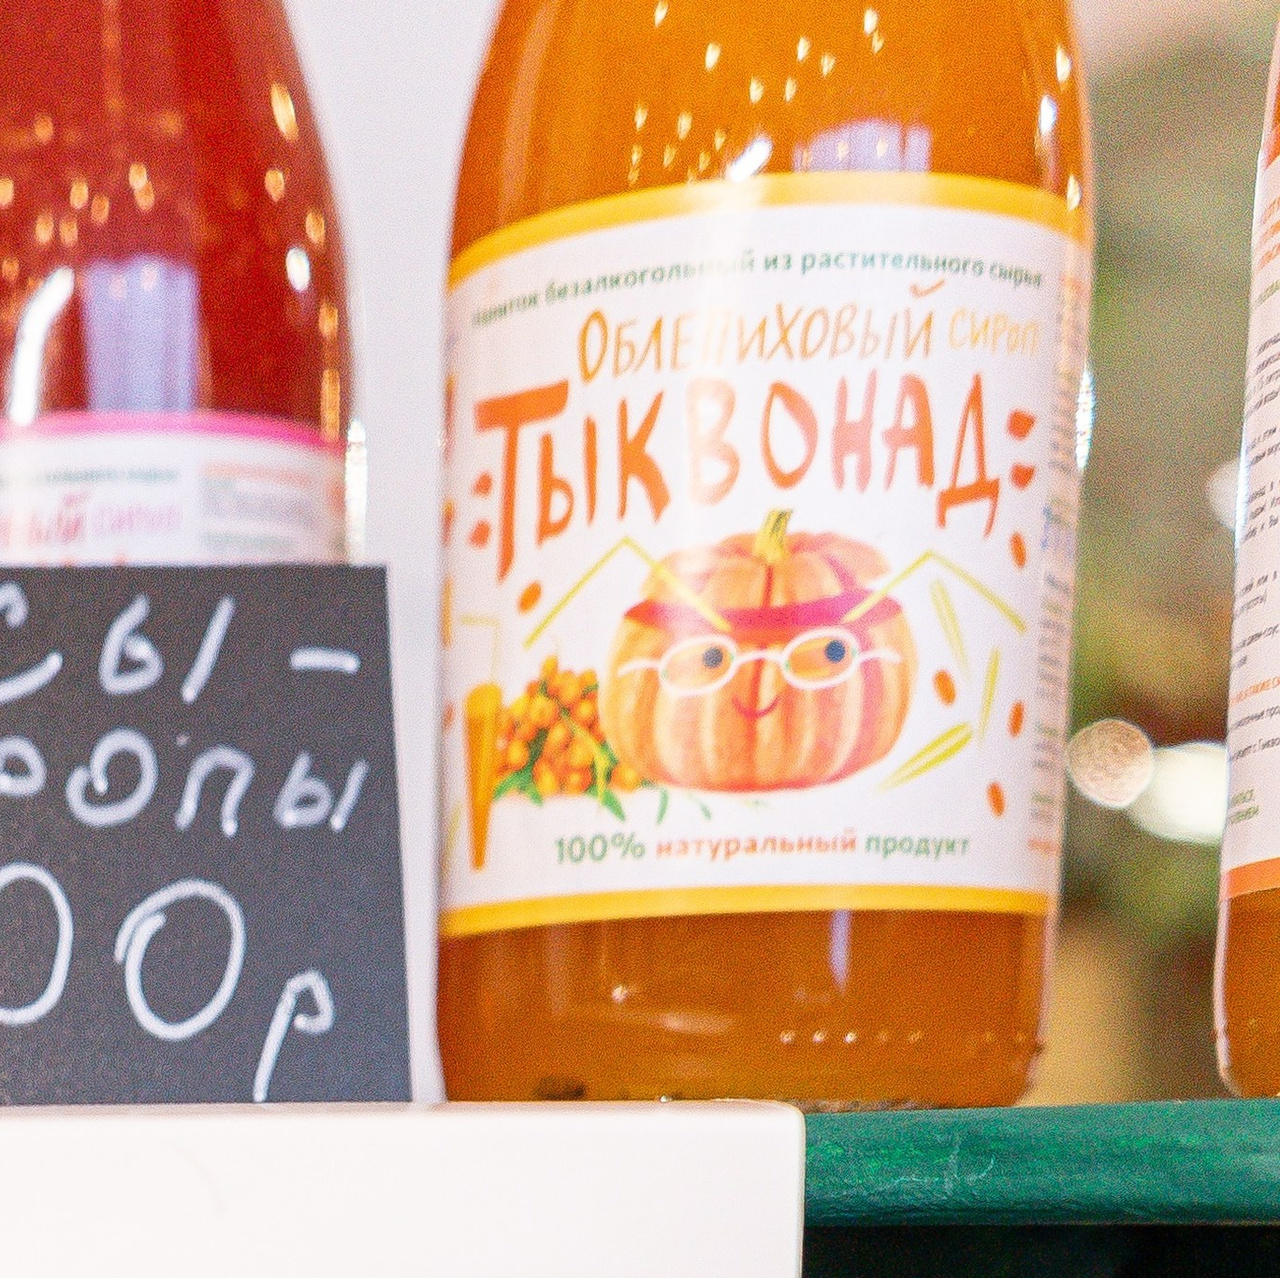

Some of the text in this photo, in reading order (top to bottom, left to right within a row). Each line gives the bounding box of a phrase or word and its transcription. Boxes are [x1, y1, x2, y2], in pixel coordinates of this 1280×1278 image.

[554, 827, 972, 866] 100% натуральный продукт
